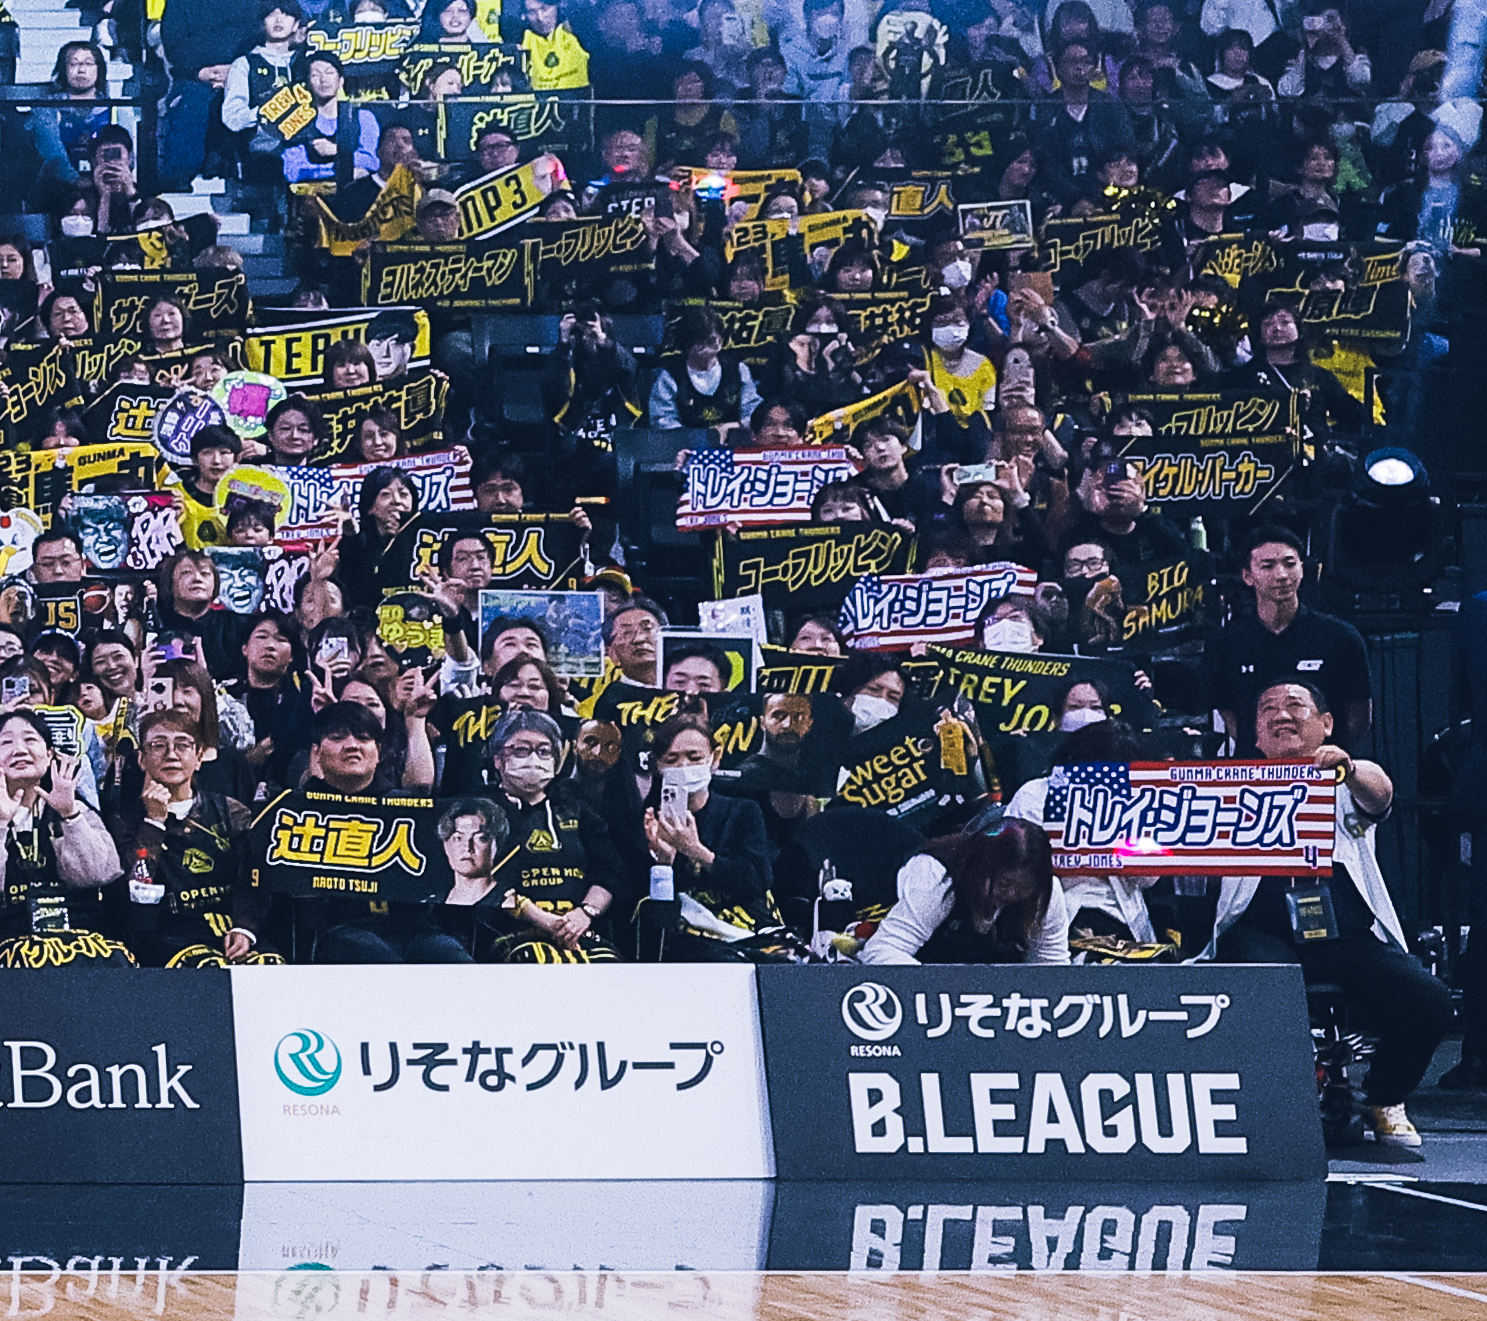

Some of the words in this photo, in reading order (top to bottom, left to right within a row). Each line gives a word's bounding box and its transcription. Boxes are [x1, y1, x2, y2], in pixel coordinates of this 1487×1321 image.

[1146, 562, 1189, 602] BIG
[953, 649, 996, 668] CRANE
[1000, 655, 1070, 677] THUNDERS
[616, 694, 678, 726] THE
[1170, 766, 1210, 781] GUNMA
[1215, 766, 1254, 780] CRANE
[1257, 766, 1322, 780] THUNDERS
[1064, 785, 1306, 848] トレイ・ジョーンズ
[274, 812, 421, 870] 辻直人
[1084, 855, 1122, 868] JONES
[1303, 845, 1317, 869] 4
[251, 869, 259, 886] 9
[348, 877, 378, 893] TSUJI
[917, 993, 1231, 1039] りそなグループ
[850, 1045, 901, 1057] RESONA
[362, 1040, 724, 1091] りそなグループ
[282, 1104, 341, 1116] RESONA
[849, 1073, 1247, 1154] B.LEAGUE
